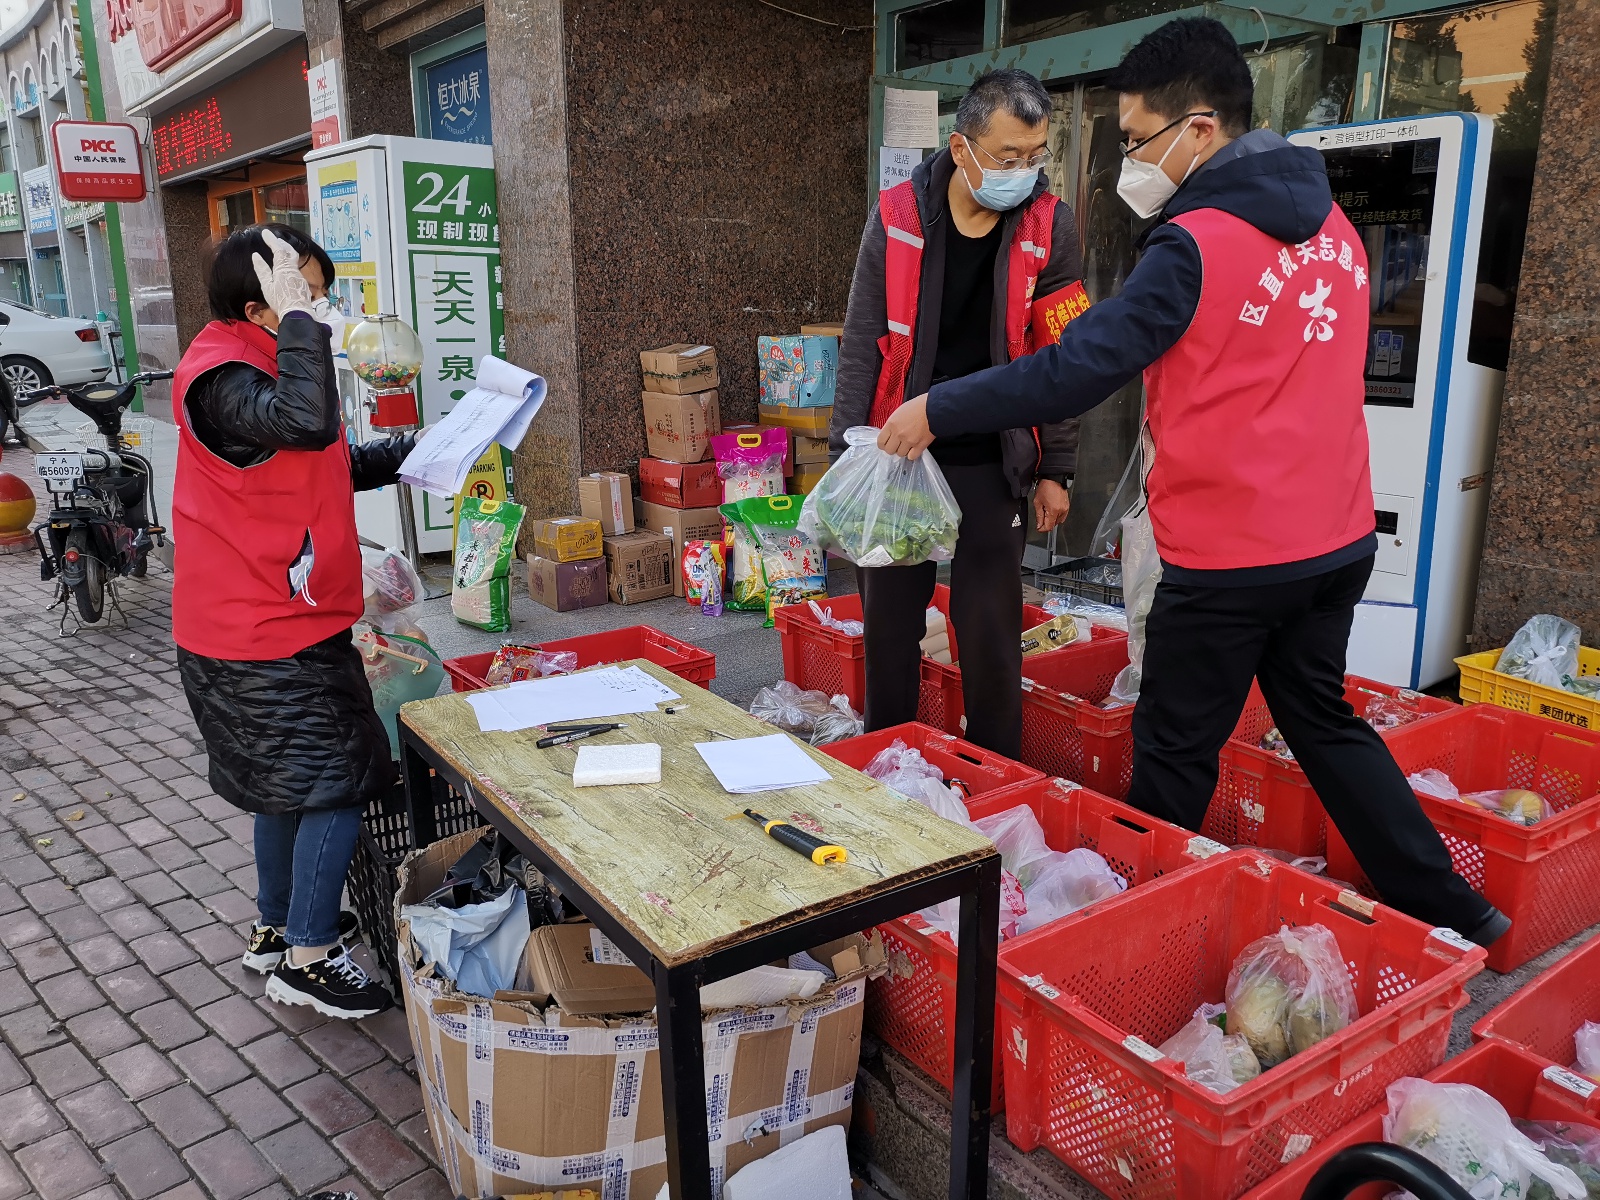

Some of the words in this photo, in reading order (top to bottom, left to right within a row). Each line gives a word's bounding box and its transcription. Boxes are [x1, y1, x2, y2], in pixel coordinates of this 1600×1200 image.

[437, 70, 481, 111] 恒大冰泉
[1335, 124, 1419, 145] 营销型打印一体机
[80, 139, 117, 153] PICC
[73, 155, 127, 164] 中国人民保险
[894, 152, 910, 165] 进店
[411, 171, 472, 216] 24
[1347, 208, 1423, 225] 已经陆续发货
[49, 456, 58, 465] 宁
[39, 465, 81, 477] 临560972
[473, 462, 496, 474] PARKING
[1539, 703, 1589, 729] 美团优选
